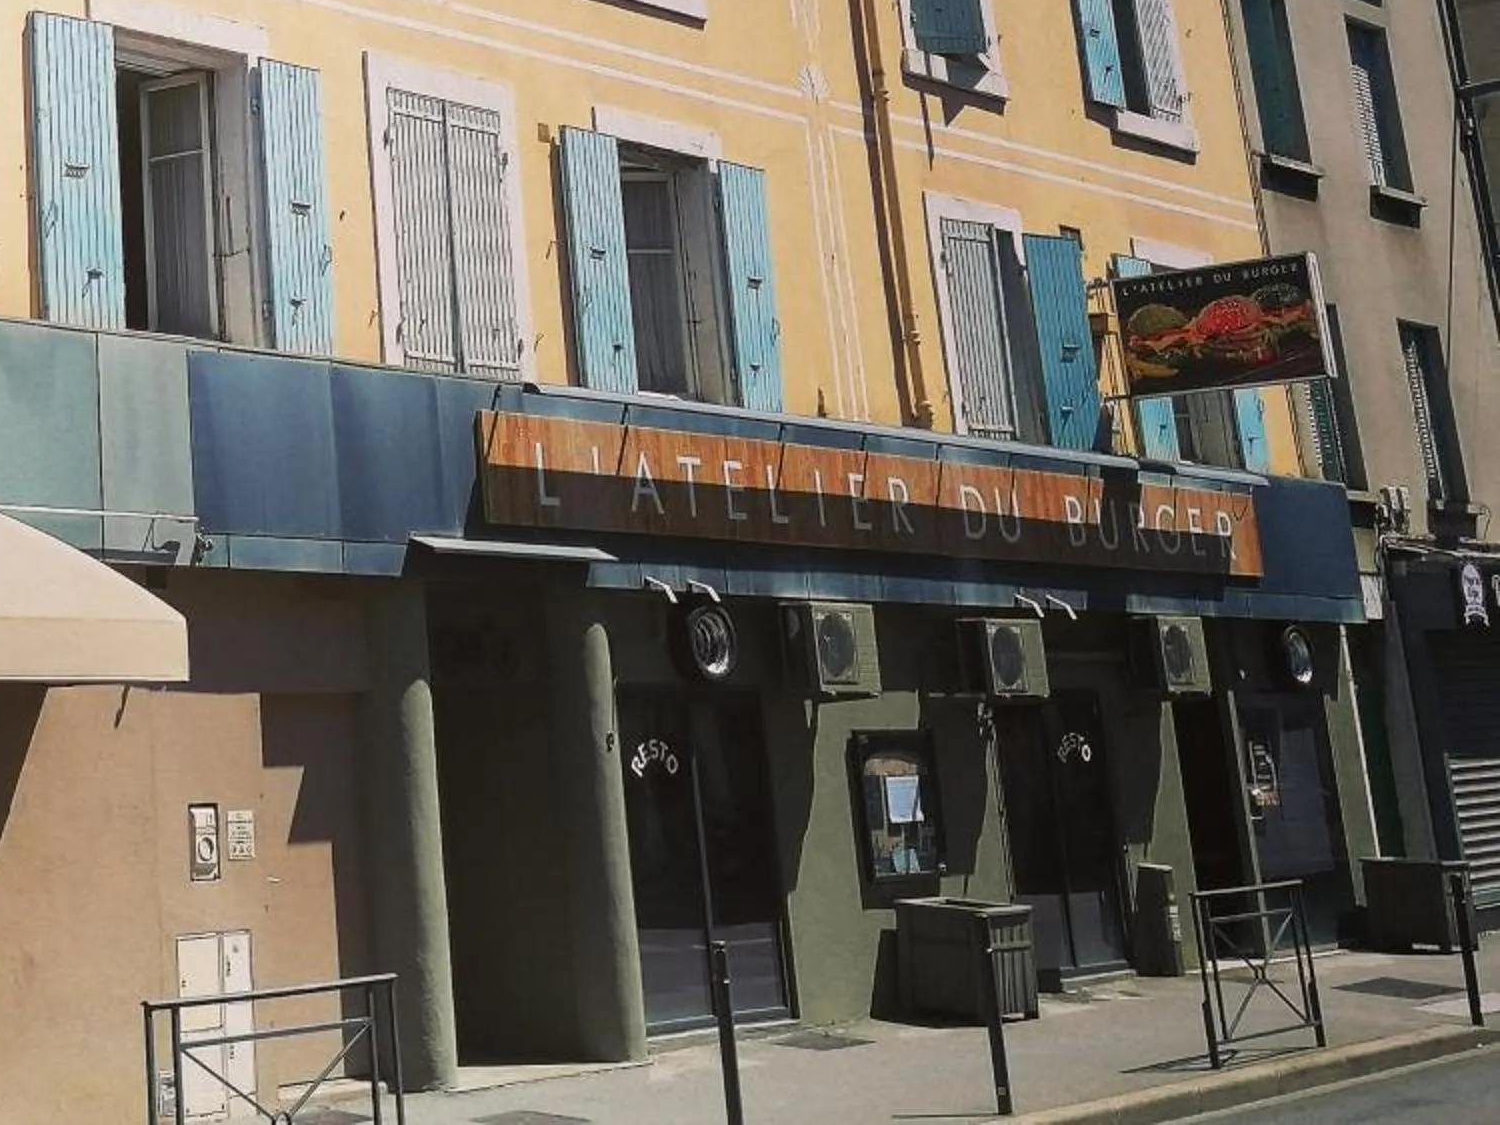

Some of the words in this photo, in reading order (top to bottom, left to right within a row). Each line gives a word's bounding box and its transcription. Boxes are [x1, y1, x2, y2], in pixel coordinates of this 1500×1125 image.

[1213, 271, 1232, 284] DU
[534, 441, 914, 535] L'ATELIER
[959, 483, 1023, 543] DU
[1063, 495, 1237, 560] BURGER
[630, 738, 680, 778] RESTO
